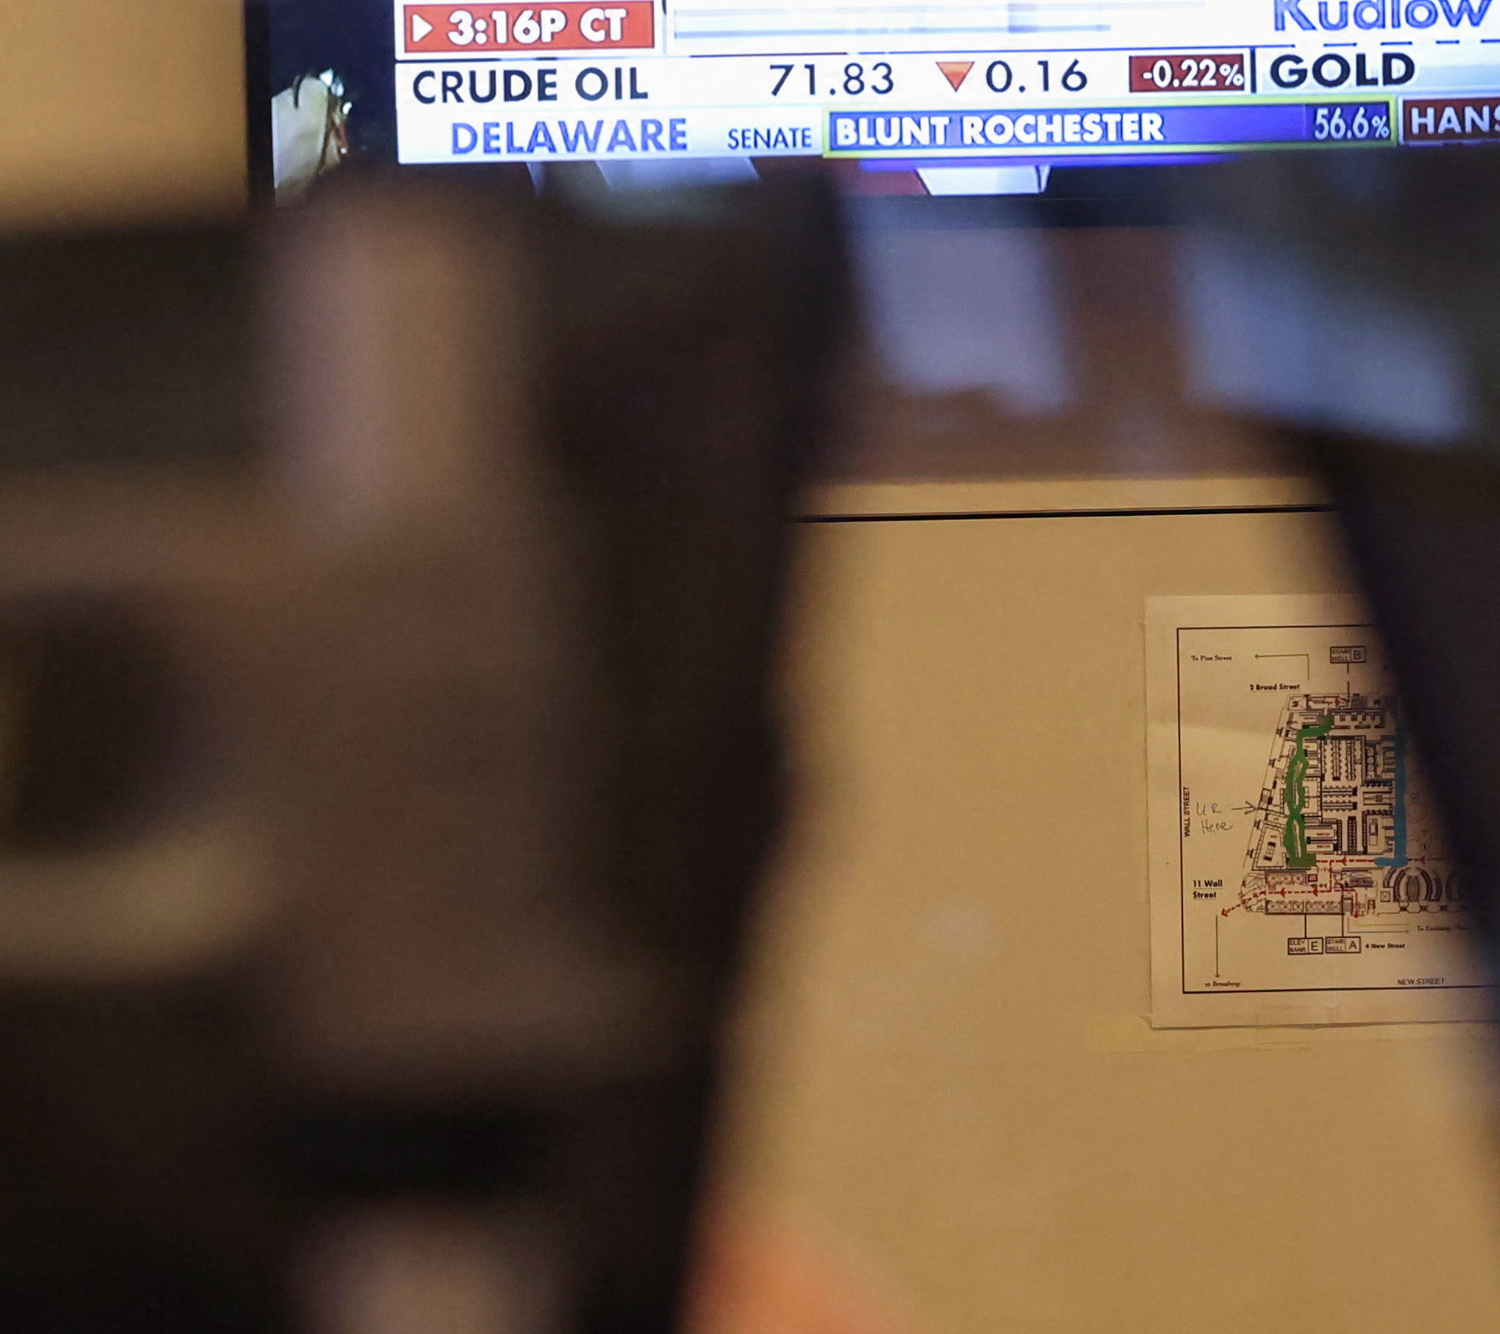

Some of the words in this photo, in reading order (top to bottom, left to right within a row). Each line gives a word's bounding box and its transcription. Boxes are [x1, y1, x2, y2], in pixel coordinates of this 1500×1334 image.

[447, 9, 566, 45] 3:16P
[579, 8, 627, 42] CT
[412, 69, 558, 104] CRUDE
[574, 66, 649, 101] OIL
[769, 62, 894, 97] 71.83
[985, 59, 1088, 93] 0.16
[1142, 59, 1244, 88] -0.22%
[1269, 52, 1416, 88] GOLD
[451, 117, 688, 154] DELAWARE
[727, 126, 812, 150] SENATE
[836, 114, 950, 147] BLUNT
[961, 112, 1165, 146] ROCHESTER
[1256, 683, 1277, 691] Broad
[1279, 683, 1300, 691] Street
[1183, 786, 1191, 815] STREET
[1204, 879, 1223, 887] Wall
[1193, 891, 1217, 899] Street
[1311, 941, 1319, 951] E
[1349, 940, 1357, 950] A
[1397, 978, 1415, 986] NEW
